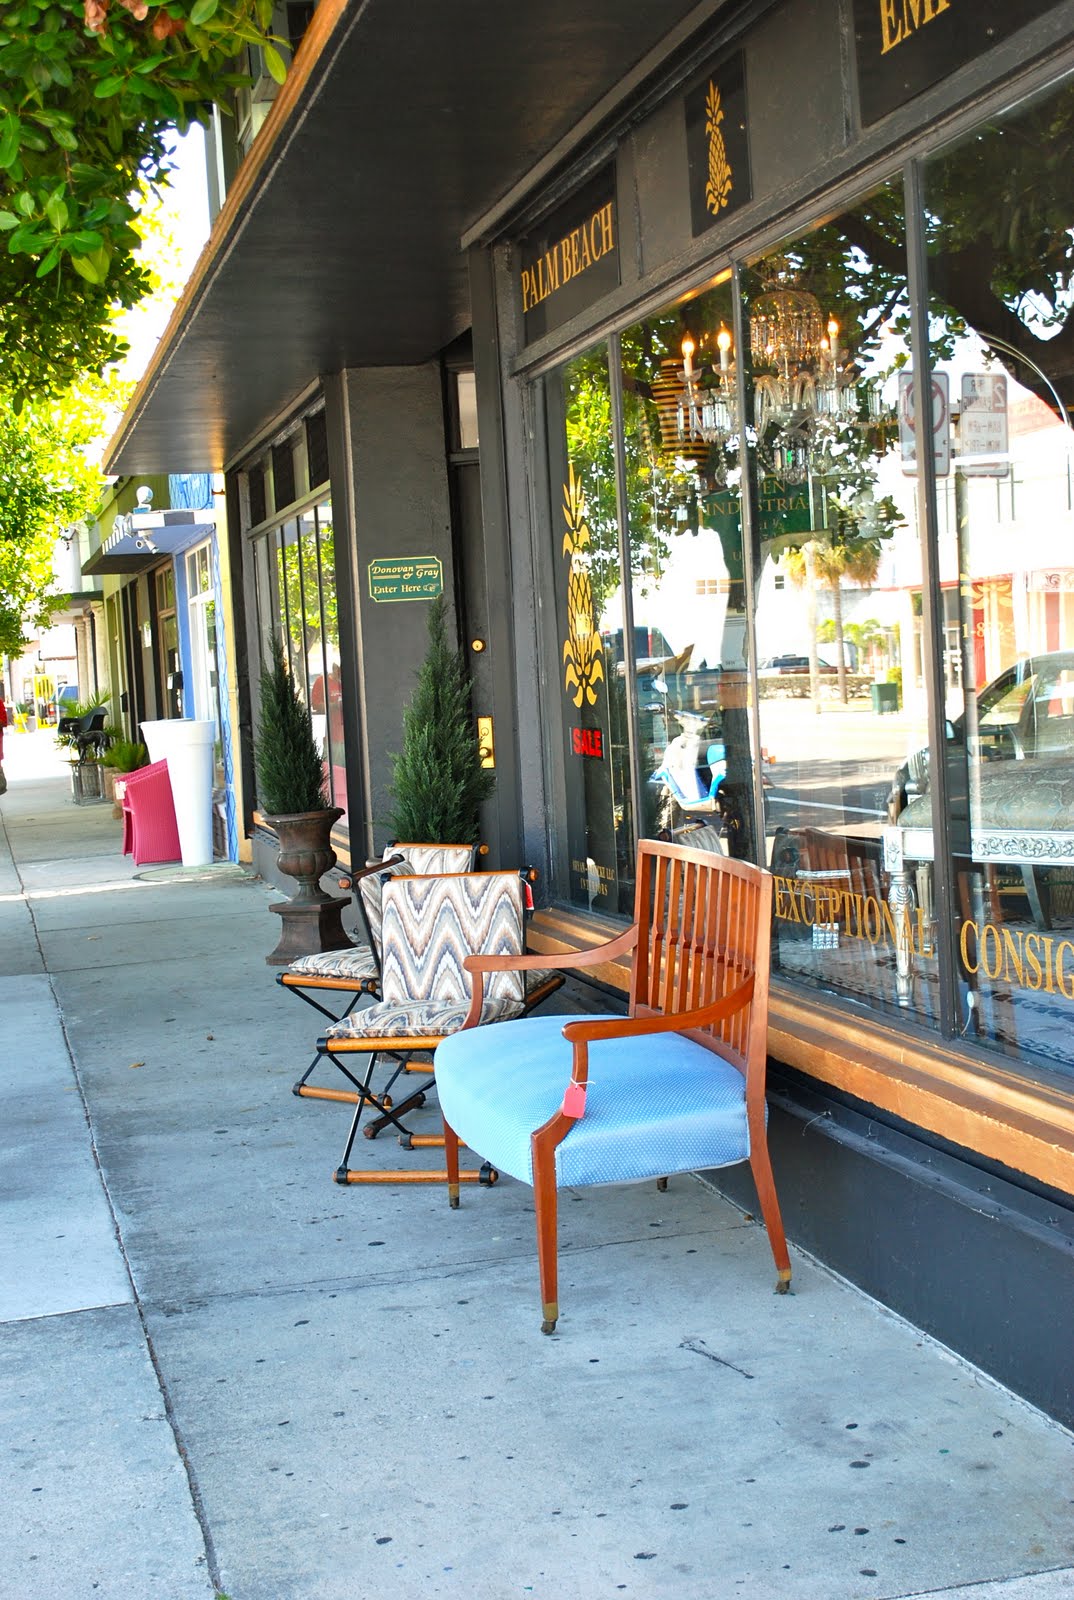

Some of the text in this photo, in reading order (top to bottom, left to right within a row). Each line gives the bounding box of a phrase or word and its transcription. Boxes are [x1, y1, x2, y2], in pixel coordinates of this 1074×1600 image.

[521, 201, 615, 313] PALM BEACH
[371, 566, 414, 575] Donovan
[415, 569, 439, 579] Gray
[373, 584, 422, 595] Enter Here
[572, 726, 602, 758] SALE
[772, 875, 934, 960] EXCEPTIONAL
